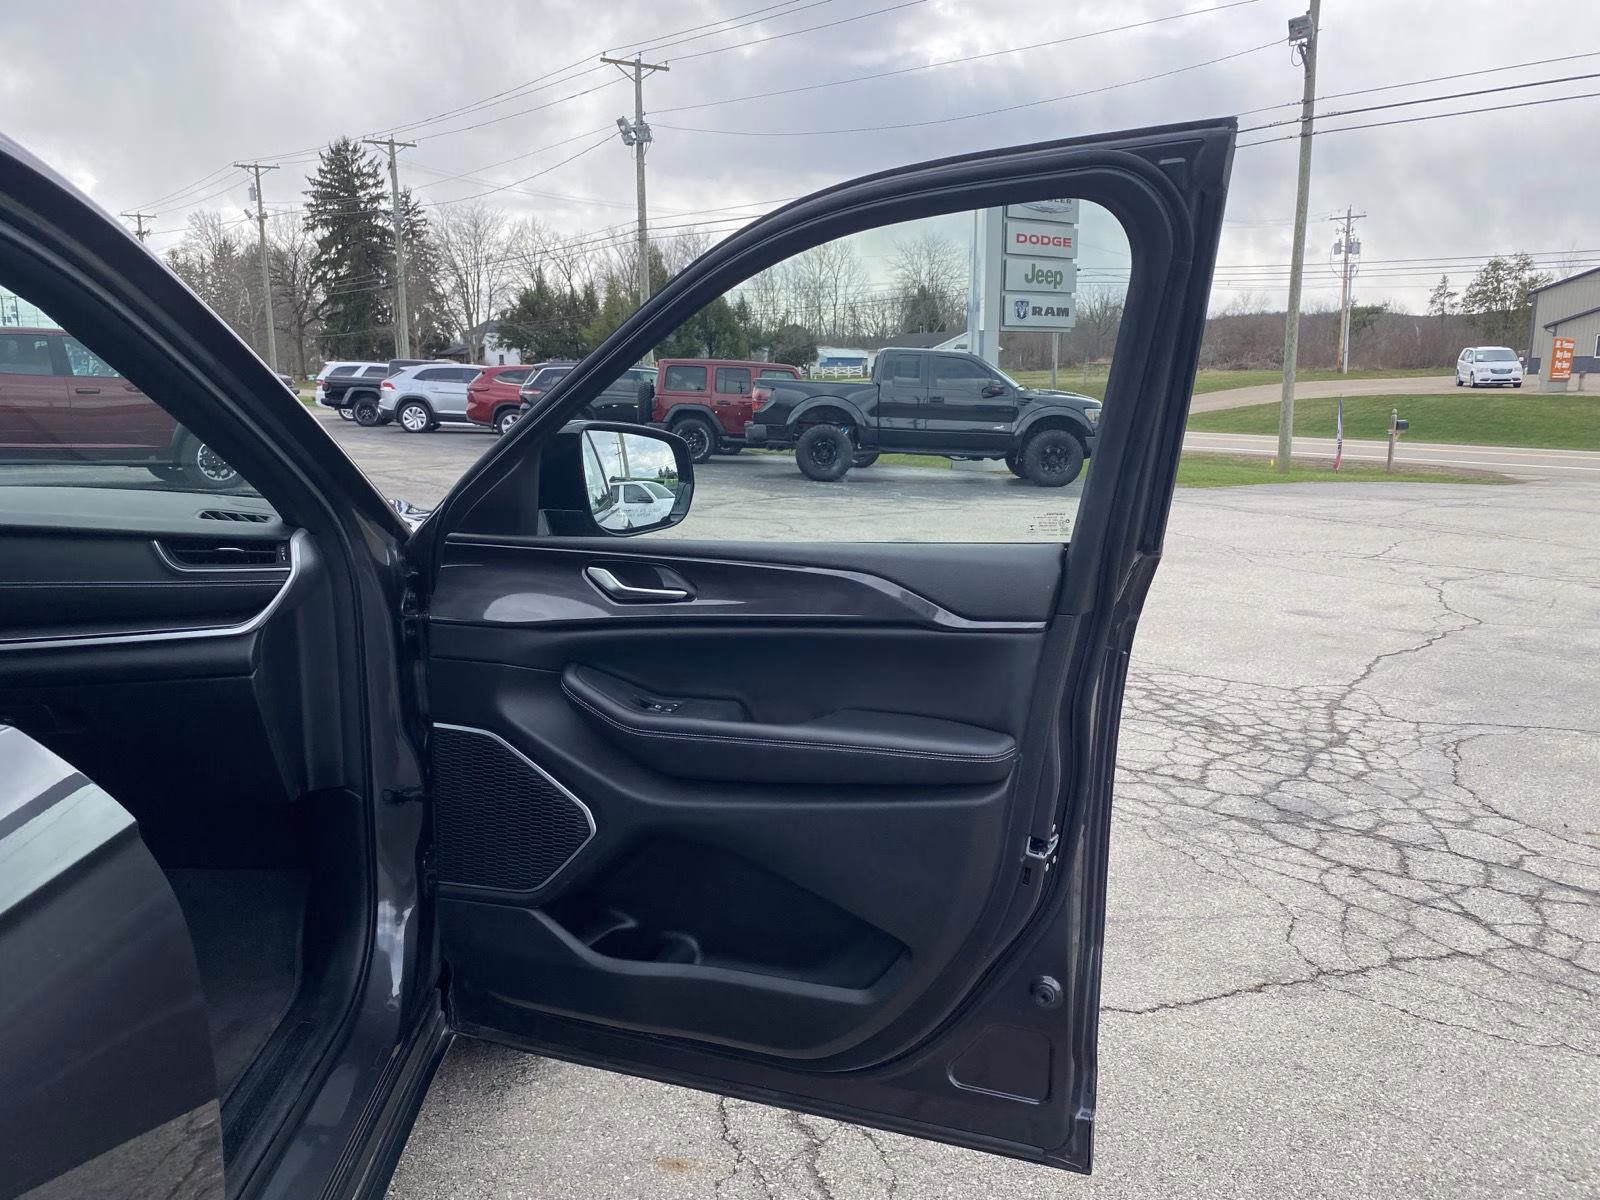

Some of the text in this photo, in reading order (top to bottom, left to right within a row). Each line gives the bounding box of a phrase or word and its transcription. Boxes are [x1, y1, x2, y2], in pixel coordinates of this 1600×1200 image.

[1016, 233, 1072, 248] DODGE
[1025, 263, 1063, 289] Jeep
[1031, 306, 1070, 317] RAM
